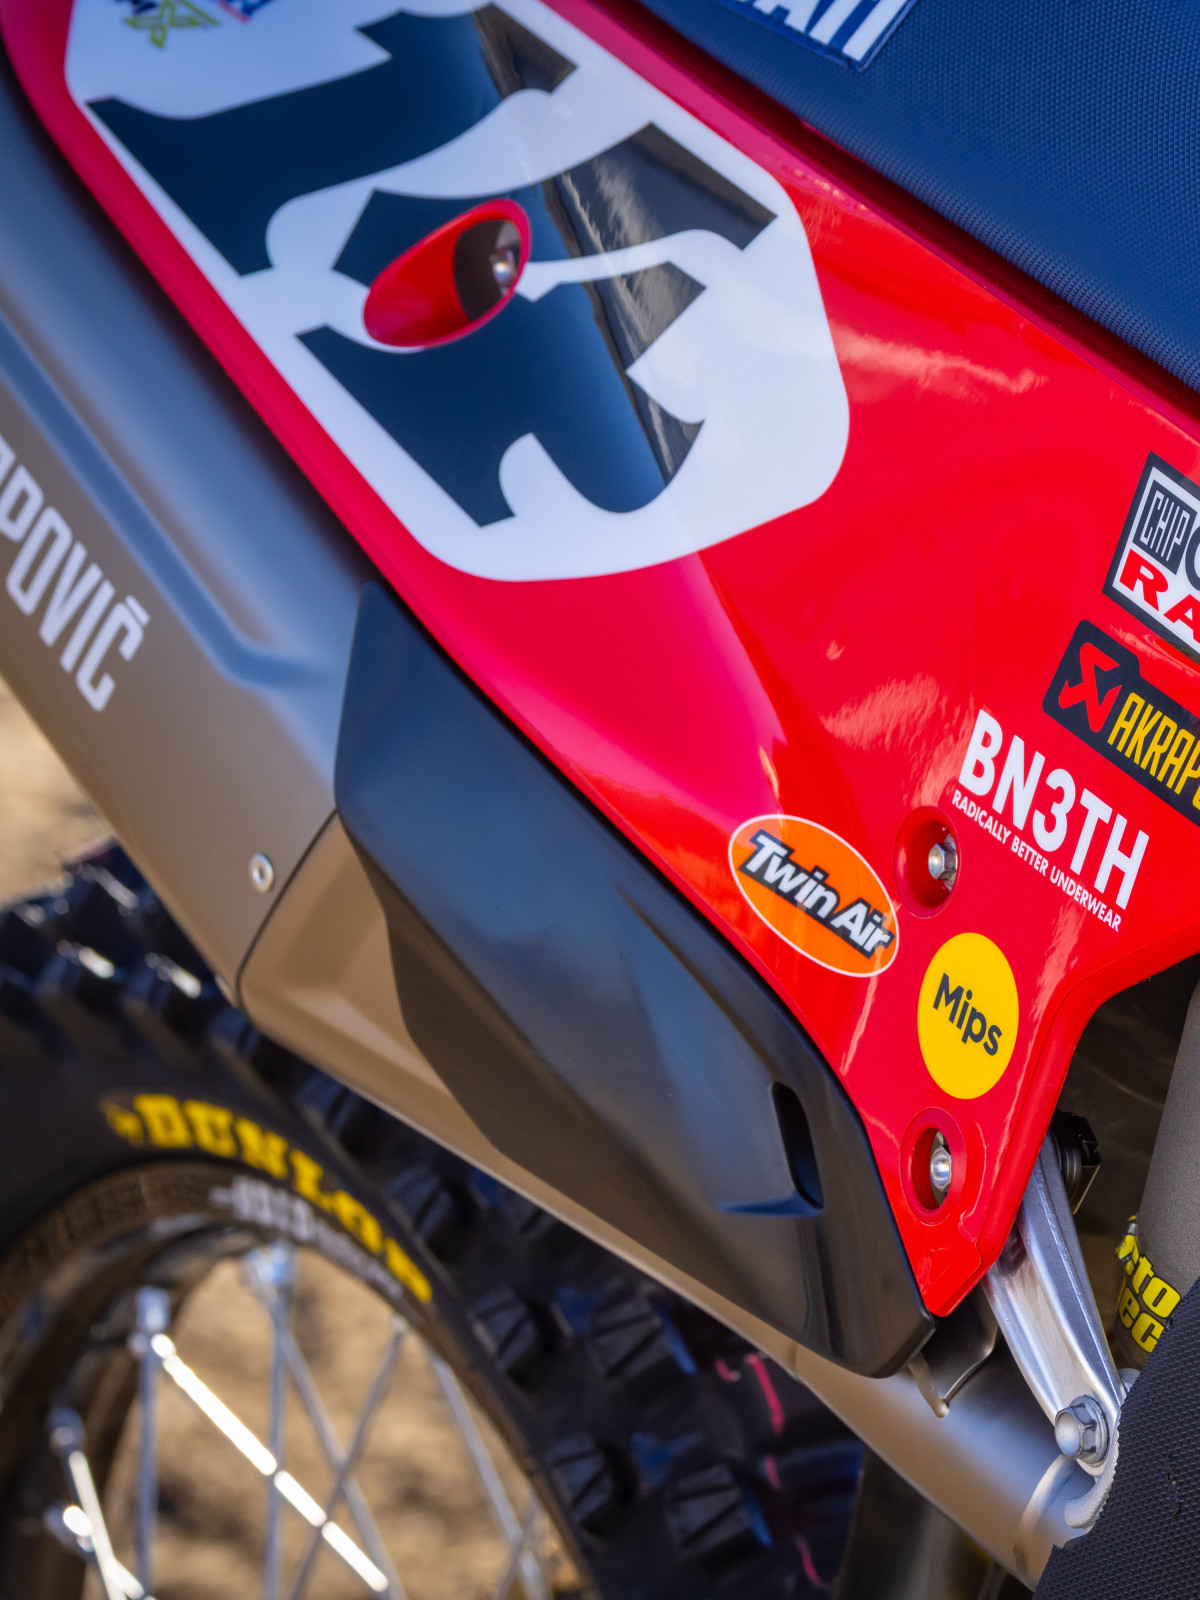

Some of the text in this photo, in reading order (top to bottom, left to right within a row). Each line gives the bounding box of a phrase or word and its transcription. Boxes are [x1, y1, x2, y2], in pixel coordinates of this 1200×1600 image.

[0, 434, 150, 712] POVIČ
[1139, 489, 1190, 562] CHIP
[952, 789, 1122, 932] RADICALLY BETTER UNDERWEAR
[958, 708, 1149, 910] BN3TH
[745, 833, 890, 953] Twin Air
[933, 972, 1002, 1056] Mips
